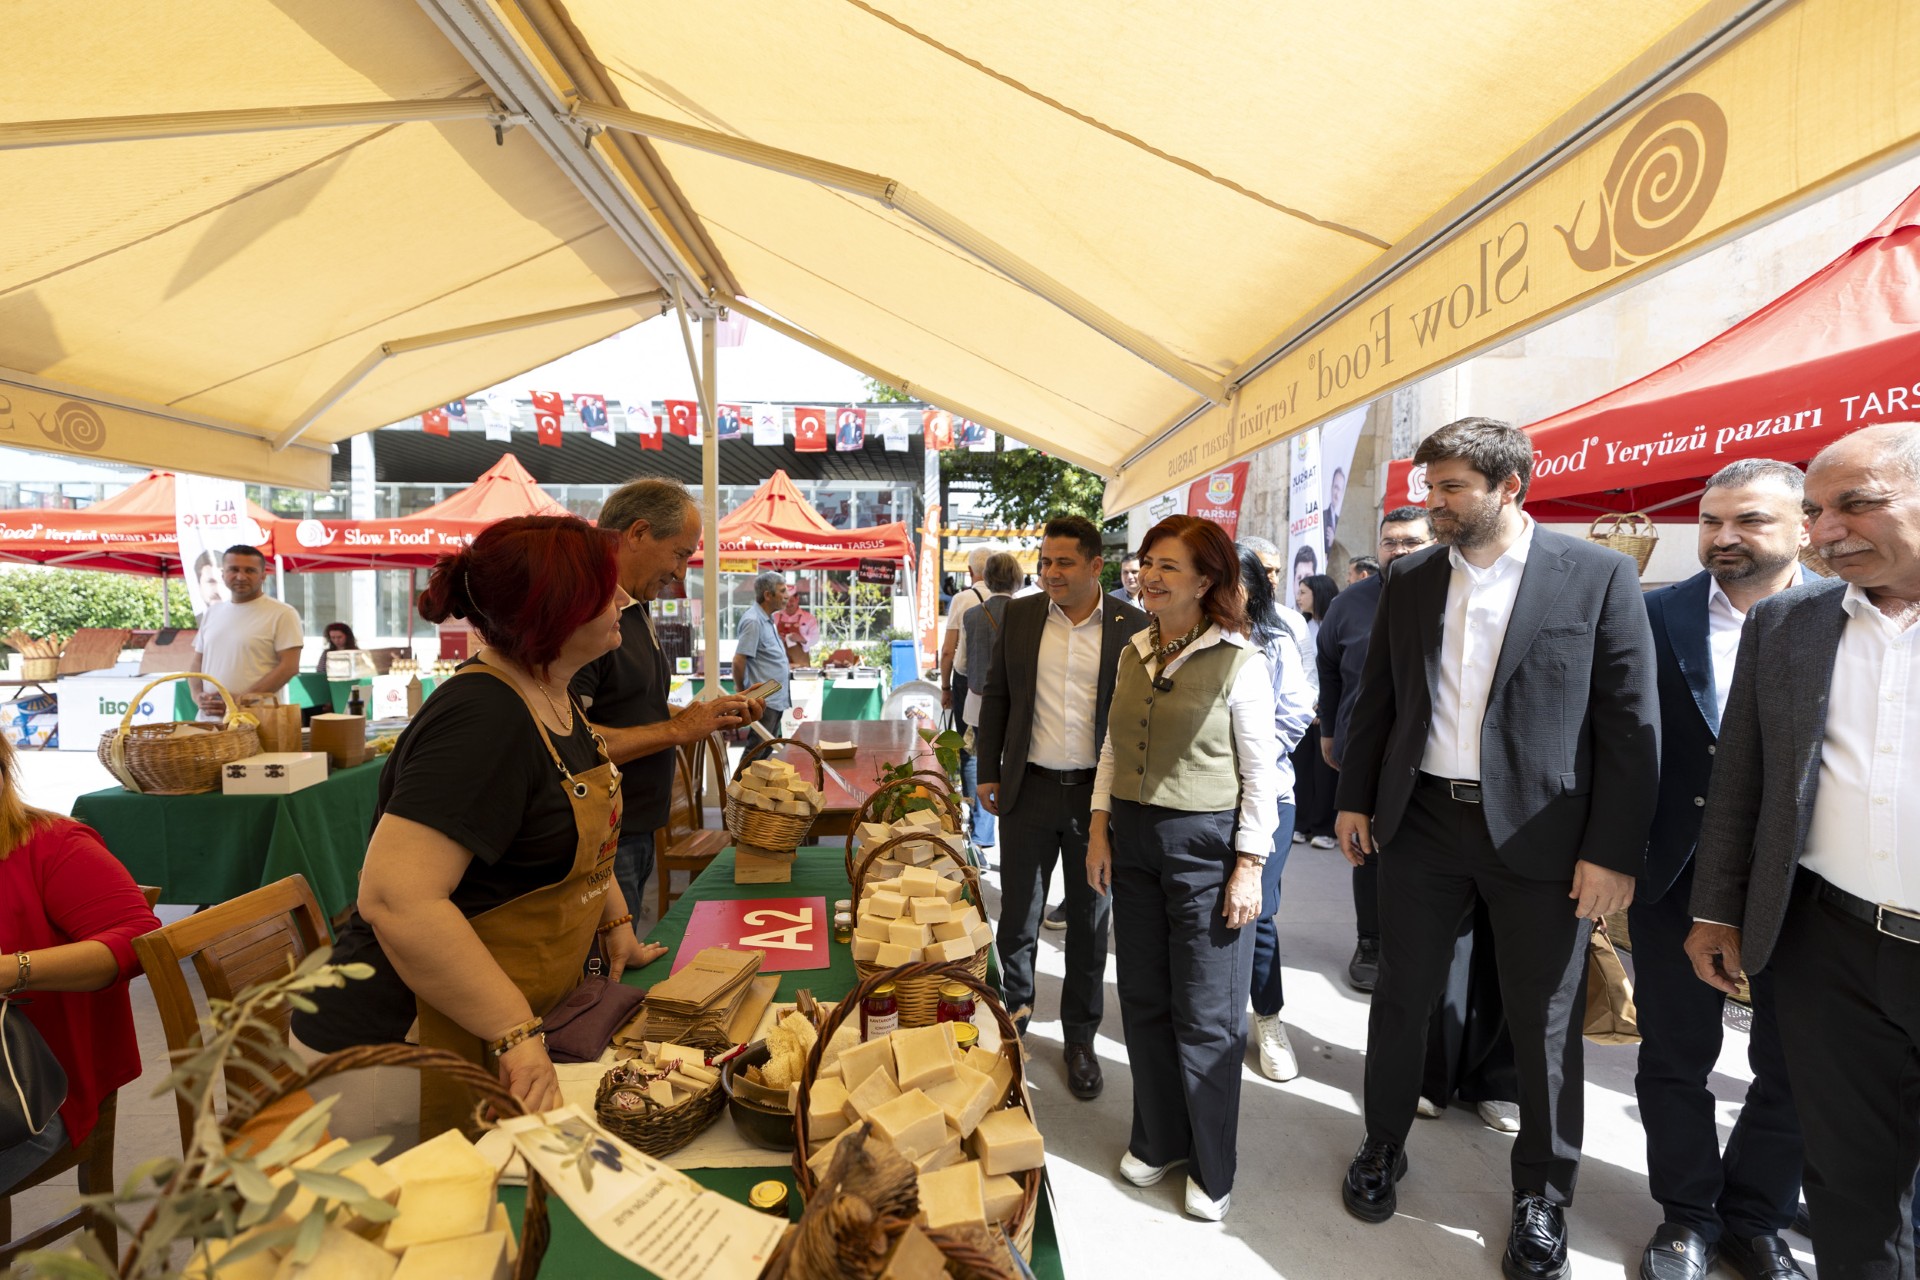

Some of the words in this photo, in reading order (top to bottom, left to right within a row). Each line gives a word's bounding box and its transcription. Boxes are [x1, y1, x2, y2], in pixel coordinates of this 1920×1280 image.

[1605, 424, 1708, 467] Yeryüzü
[1714, 408, 1823, 455] pazarı
[1196, 508, 1238, 518] TARSUS
[344, 528, 384, 545] Slow
[847, 539, 885, 550] TARSUS
[739, 907, 813, 951] A2
